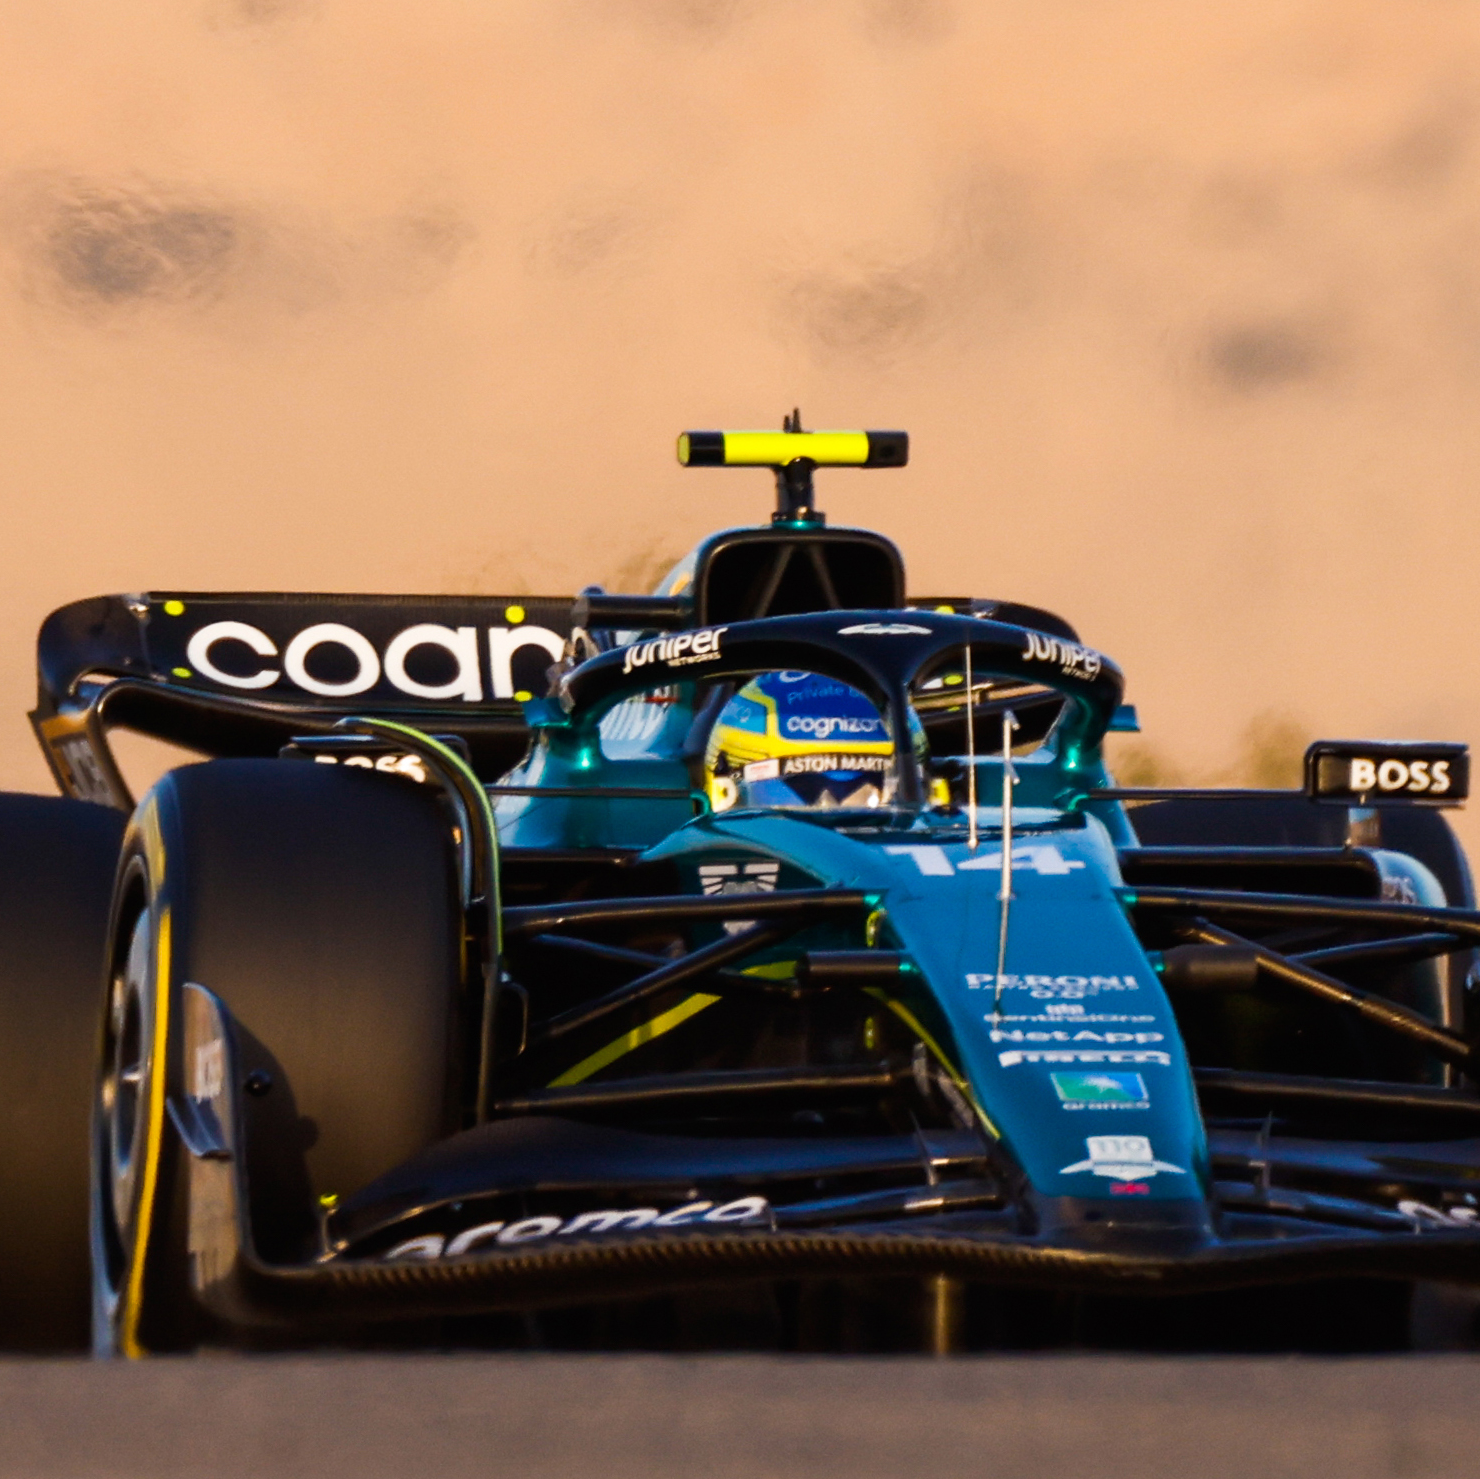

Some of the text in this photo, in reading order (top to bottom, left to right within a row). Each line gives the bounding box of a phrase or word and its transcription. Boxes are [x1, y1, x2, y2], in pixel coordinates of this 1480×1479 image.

[783, 754, 838, 774] ASTON
[1350, 758, 1451, 793] BOSS
[884, 843, 1087, 876] 14
[989, 1029, 1164, 1044] NetApp
